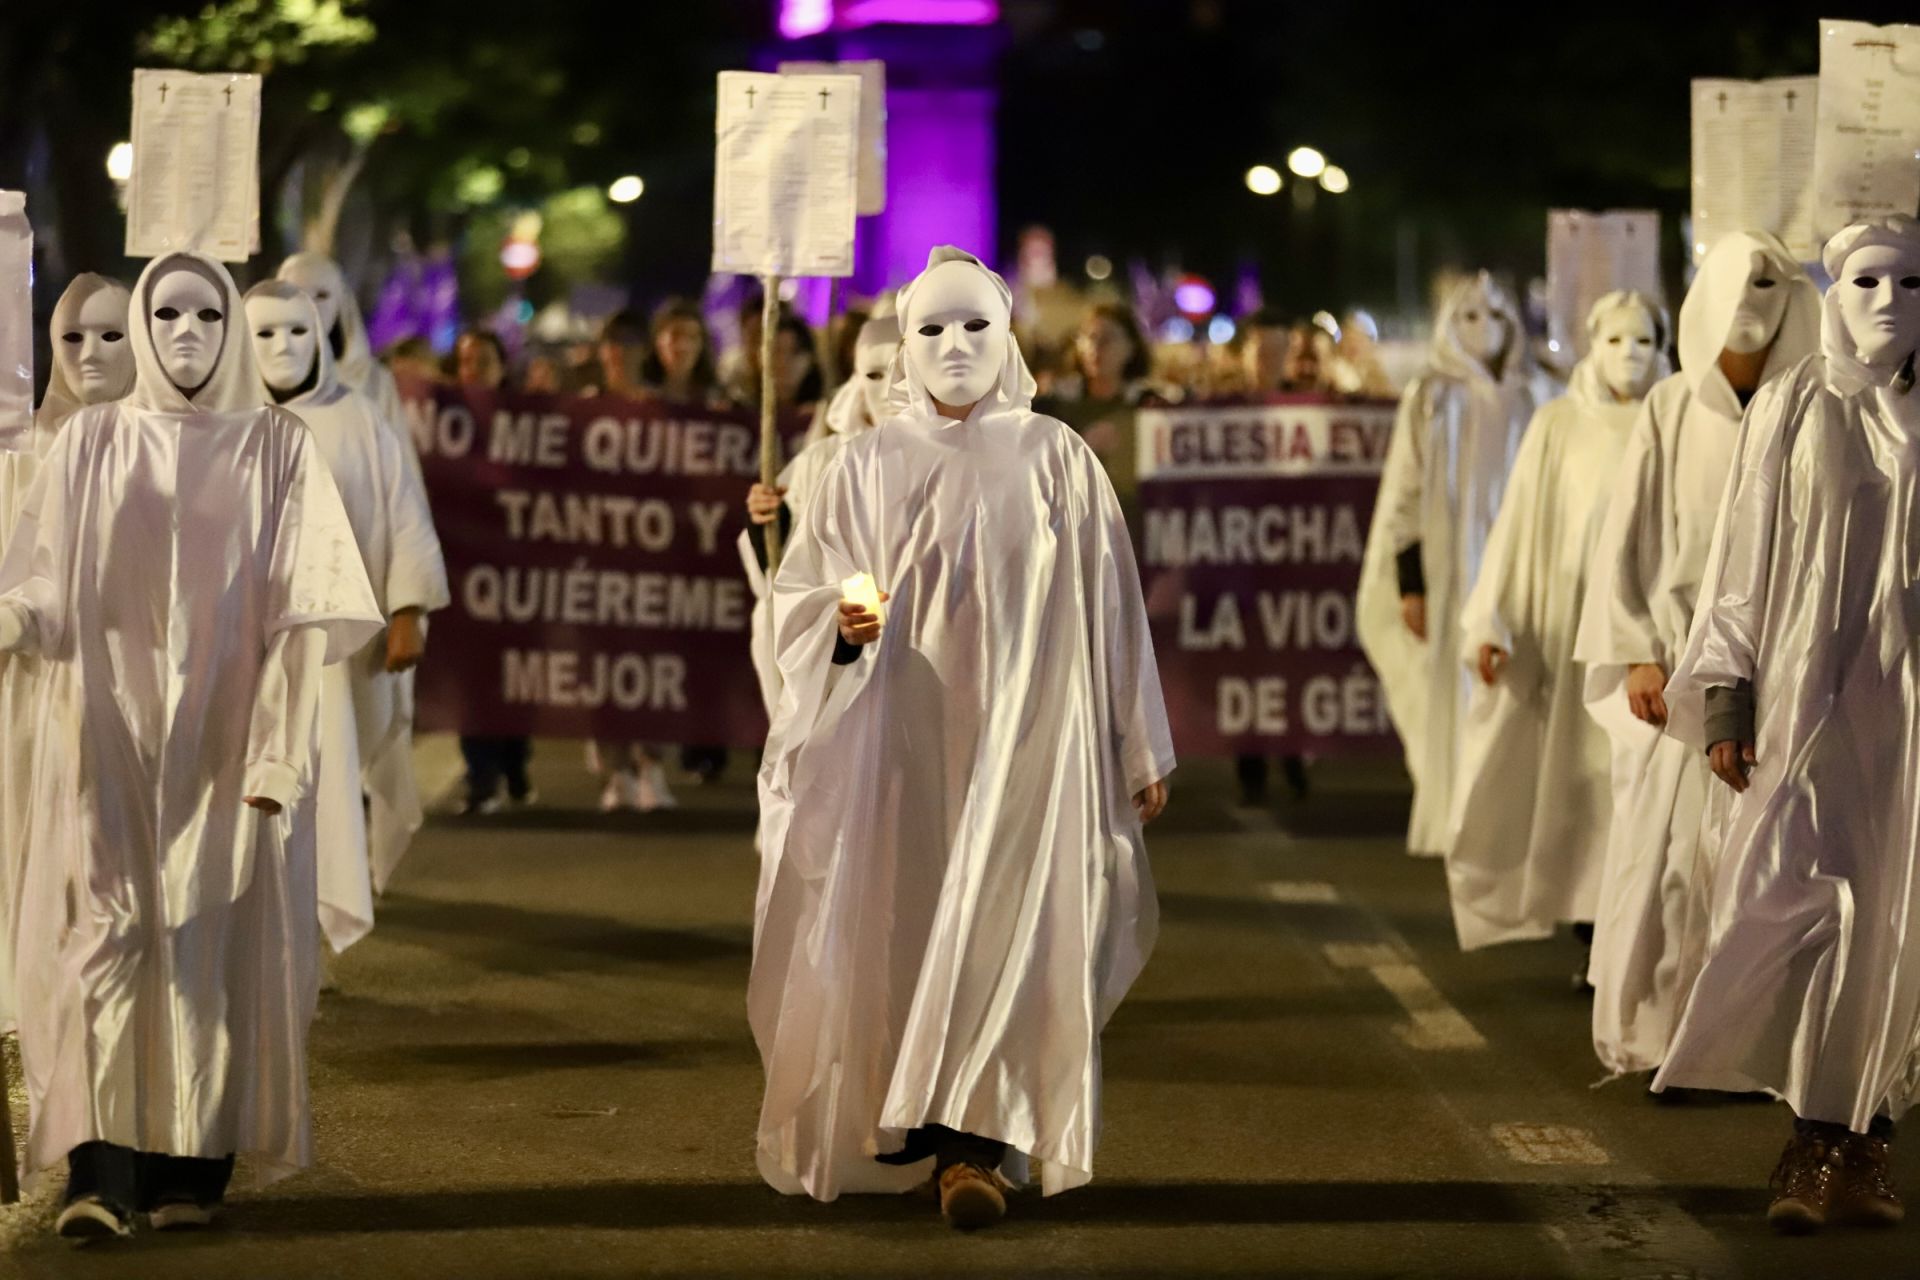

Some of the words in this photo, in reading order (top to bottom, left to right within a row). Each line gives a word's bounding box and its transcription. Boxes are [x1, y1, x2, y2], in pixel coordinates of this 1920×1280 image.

[404, 399, 475, 458] NO
[488, 411, 571, 468] ME
[1153, 420, 1313, 463] IGLESIA
[1329, 420, 1393, 463] EV
[496, 490, 672, 553] TANTO
[689, 503, 727, 554] Y
[1144, 504, 1363, 567] MARCHA
[461, 557, 746, 632] QUIÉREME
[1178, 593, 1246, 650] LA
[1257, 591, 1357, 650] VIO
[502, 648, 689, 710] MEJOR
[1217, 676, 1289, 736] DE
[1302, 664, 1391, 736] GÉ
